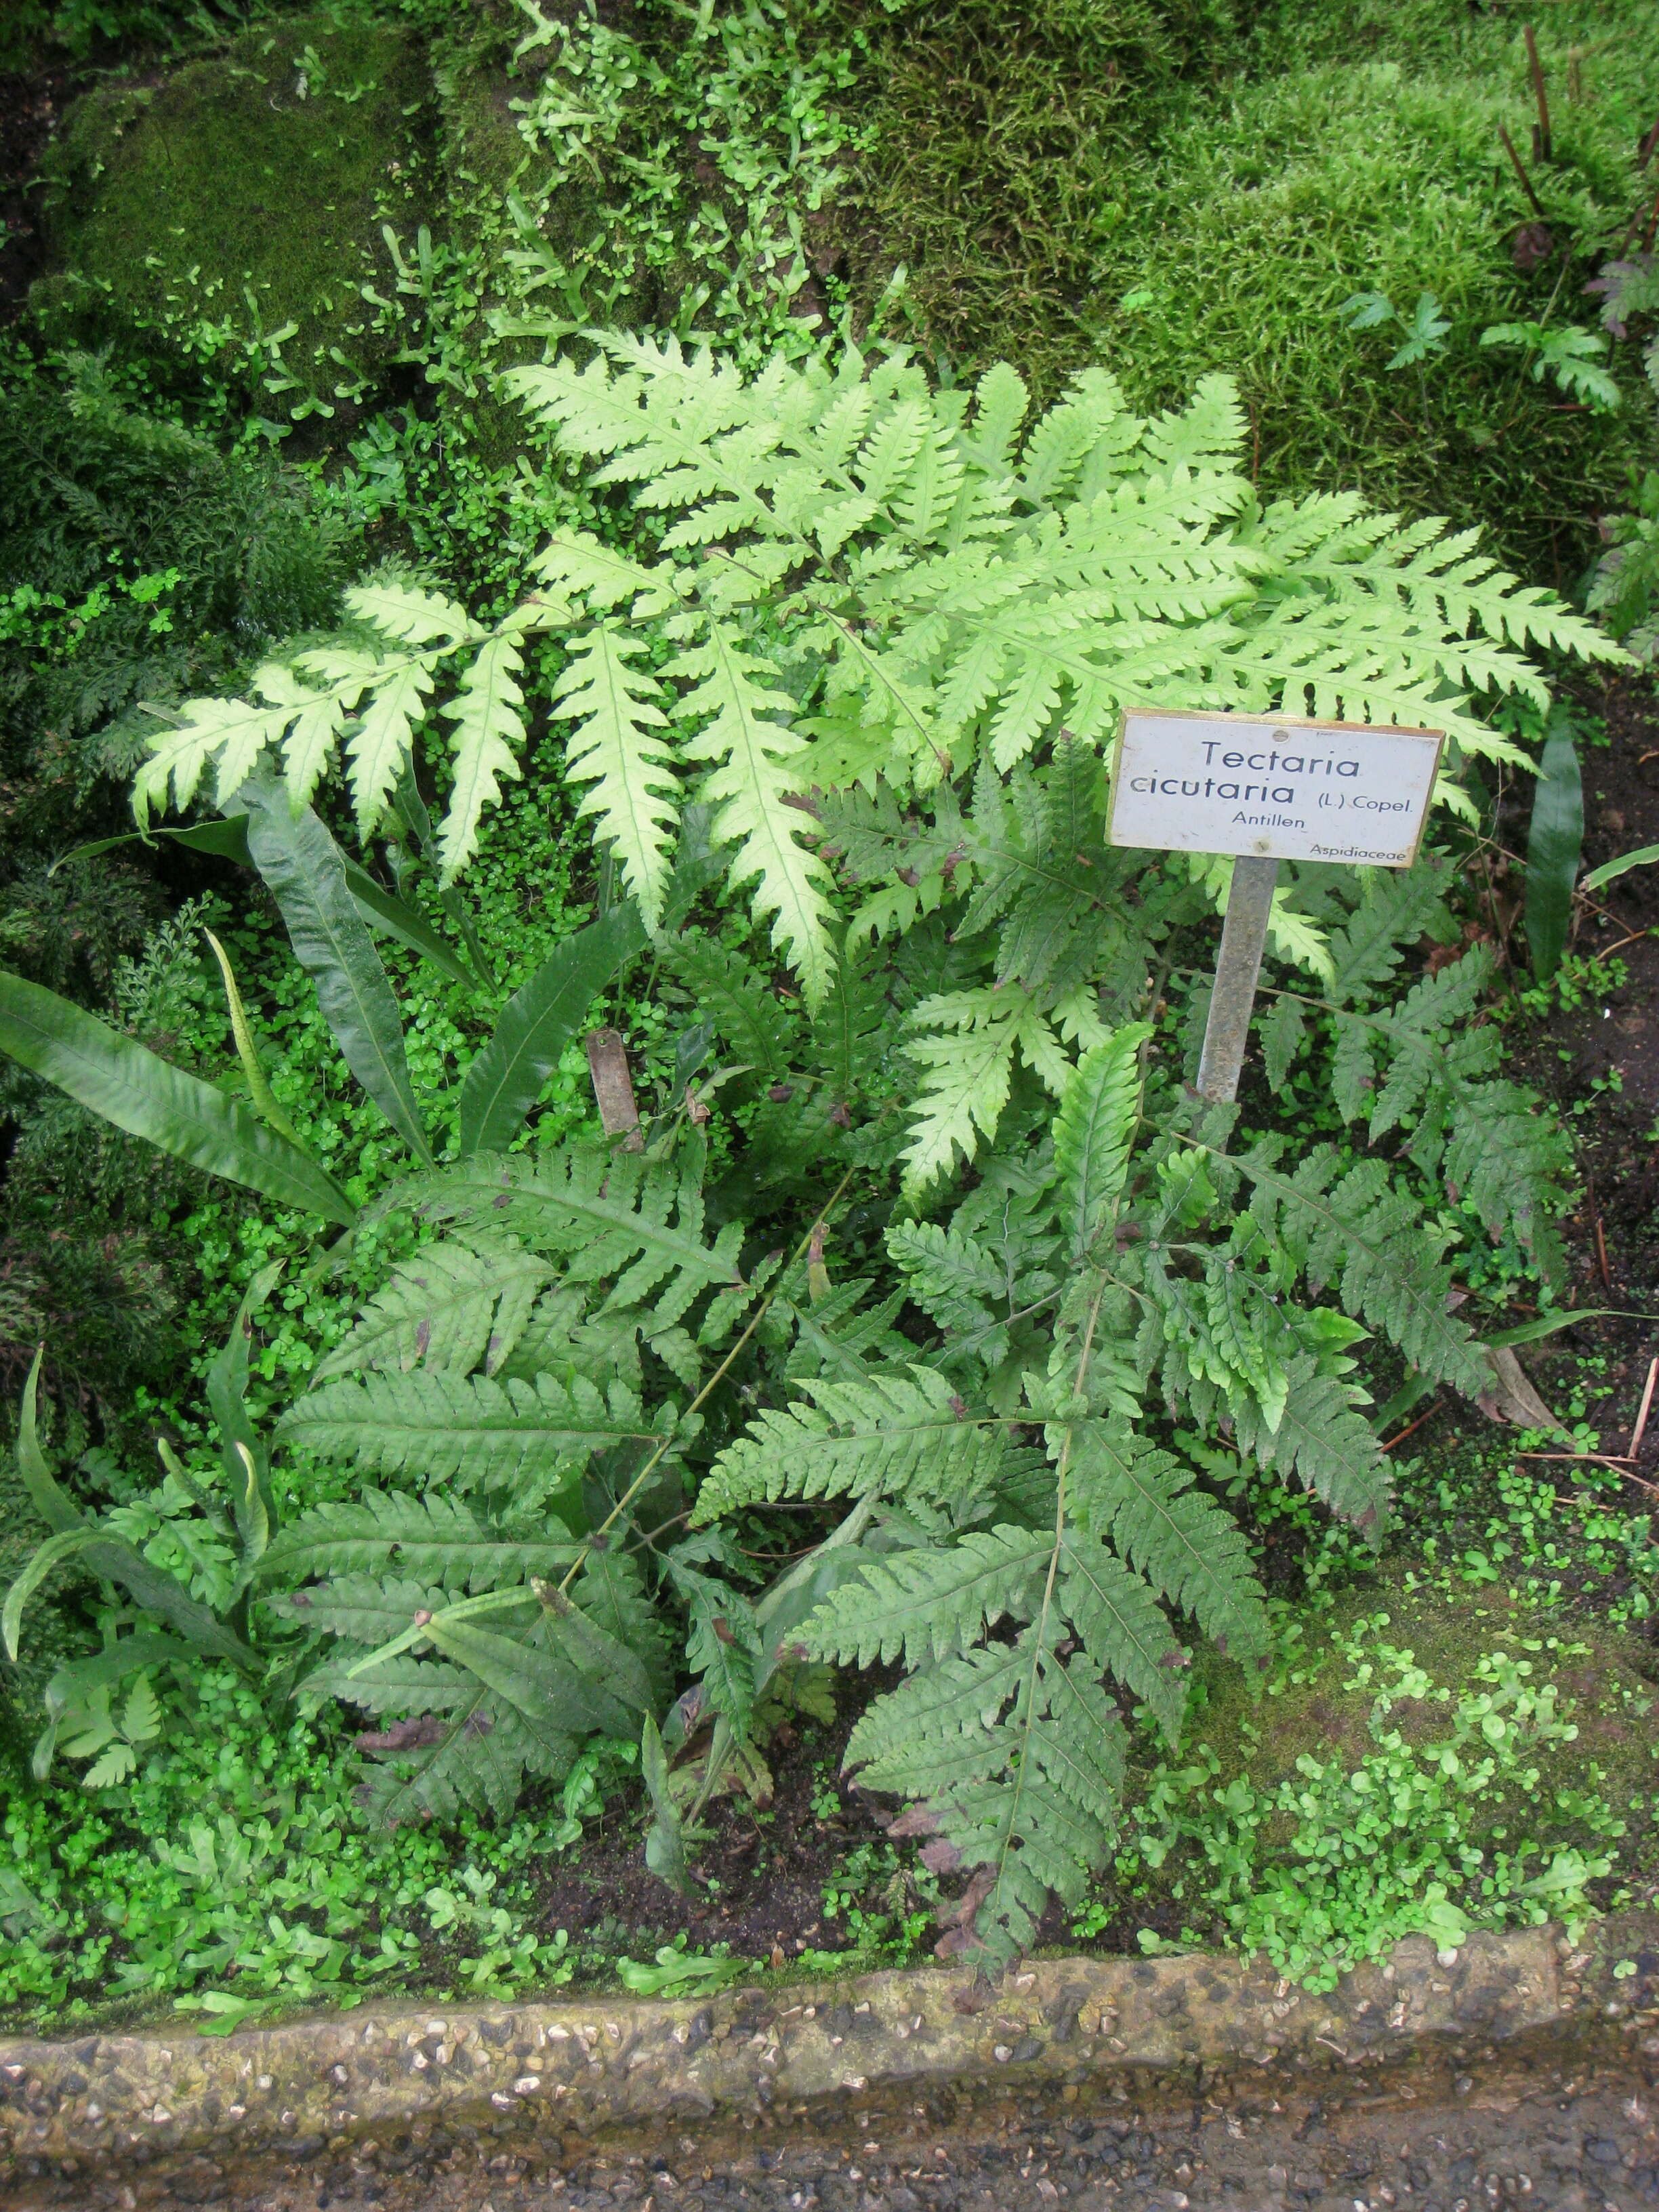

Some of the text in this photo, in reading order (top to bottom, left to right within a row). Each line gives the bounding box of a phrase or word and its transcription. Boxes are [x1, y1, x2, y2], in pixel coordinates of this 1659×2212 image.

[1201, 741, 1359, 777] Tectaria
[1130, 769, 1414, 813] cicutaria (L.) Copel.
[1232, 811, 1305, 829] Antillen
[1309, 844, 1406, 862] Aspidiaceae
